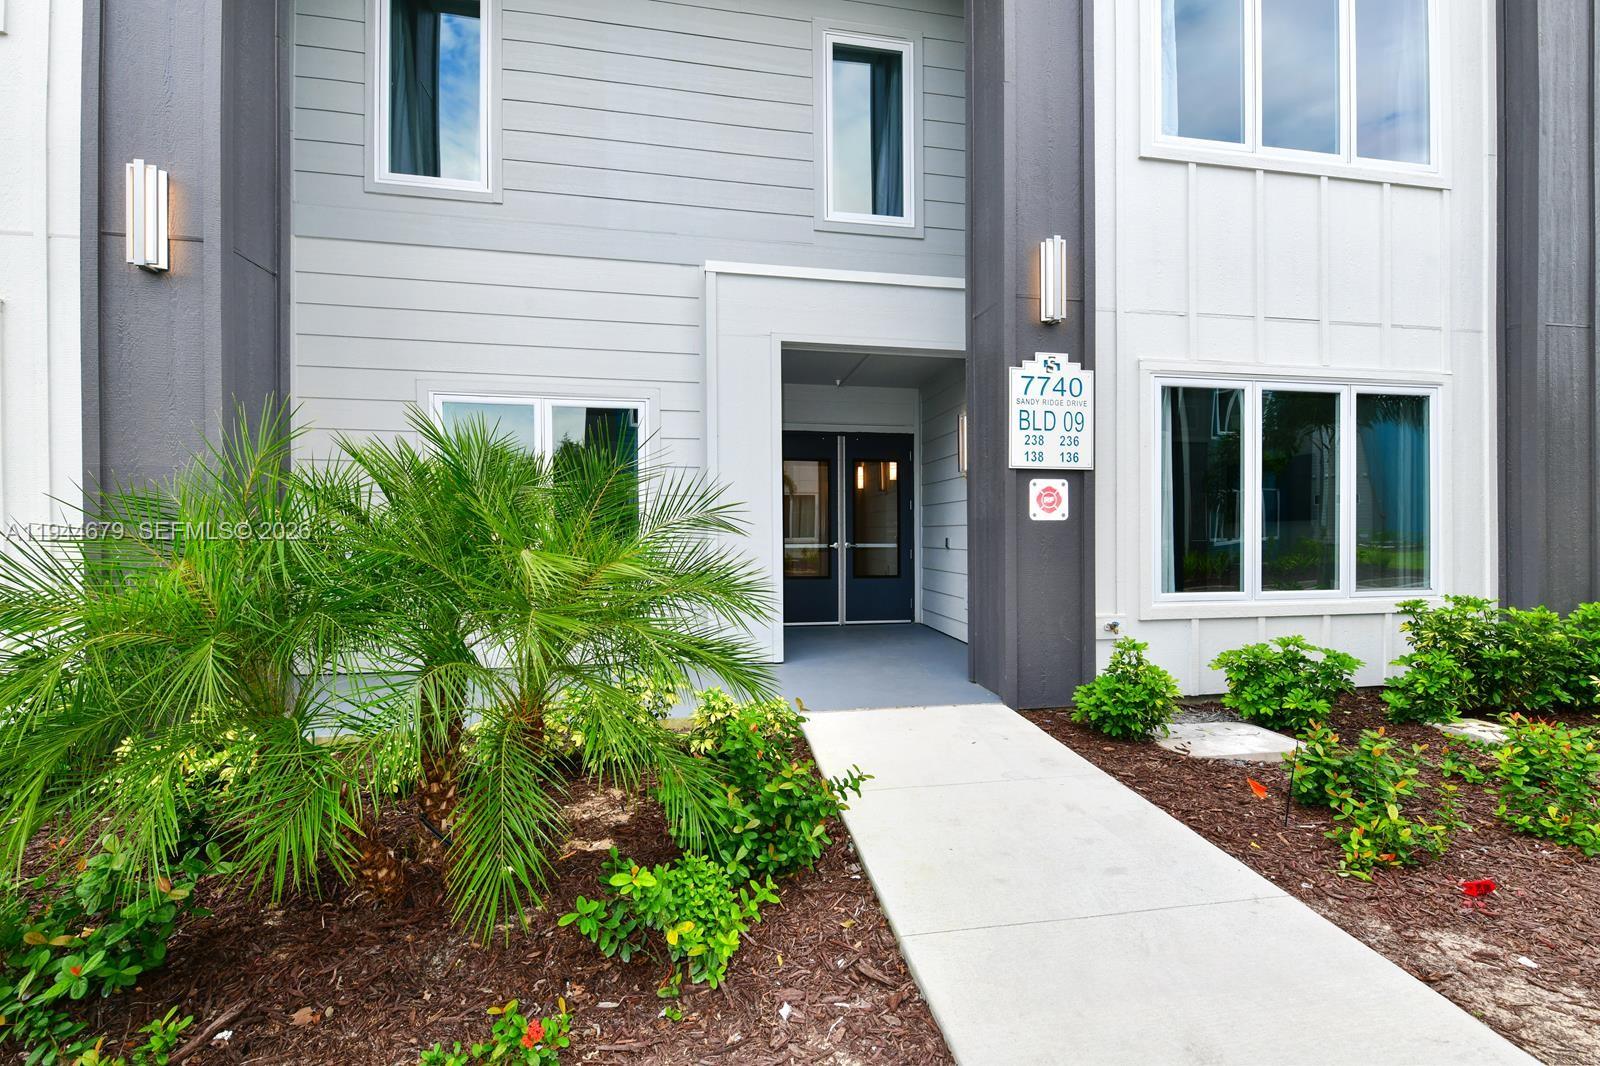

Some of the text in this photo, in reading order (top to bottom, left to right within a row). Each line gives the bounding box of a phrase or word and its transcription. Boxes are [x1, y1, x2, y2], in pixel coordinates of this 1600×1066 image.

[1021, 376, 1083, 397] 7740
[1019, 410, 1084, 432] BLD 09
[1024, 435, 1079, 446] 238 236
[1024, 451, 1079, 462] 138 136
